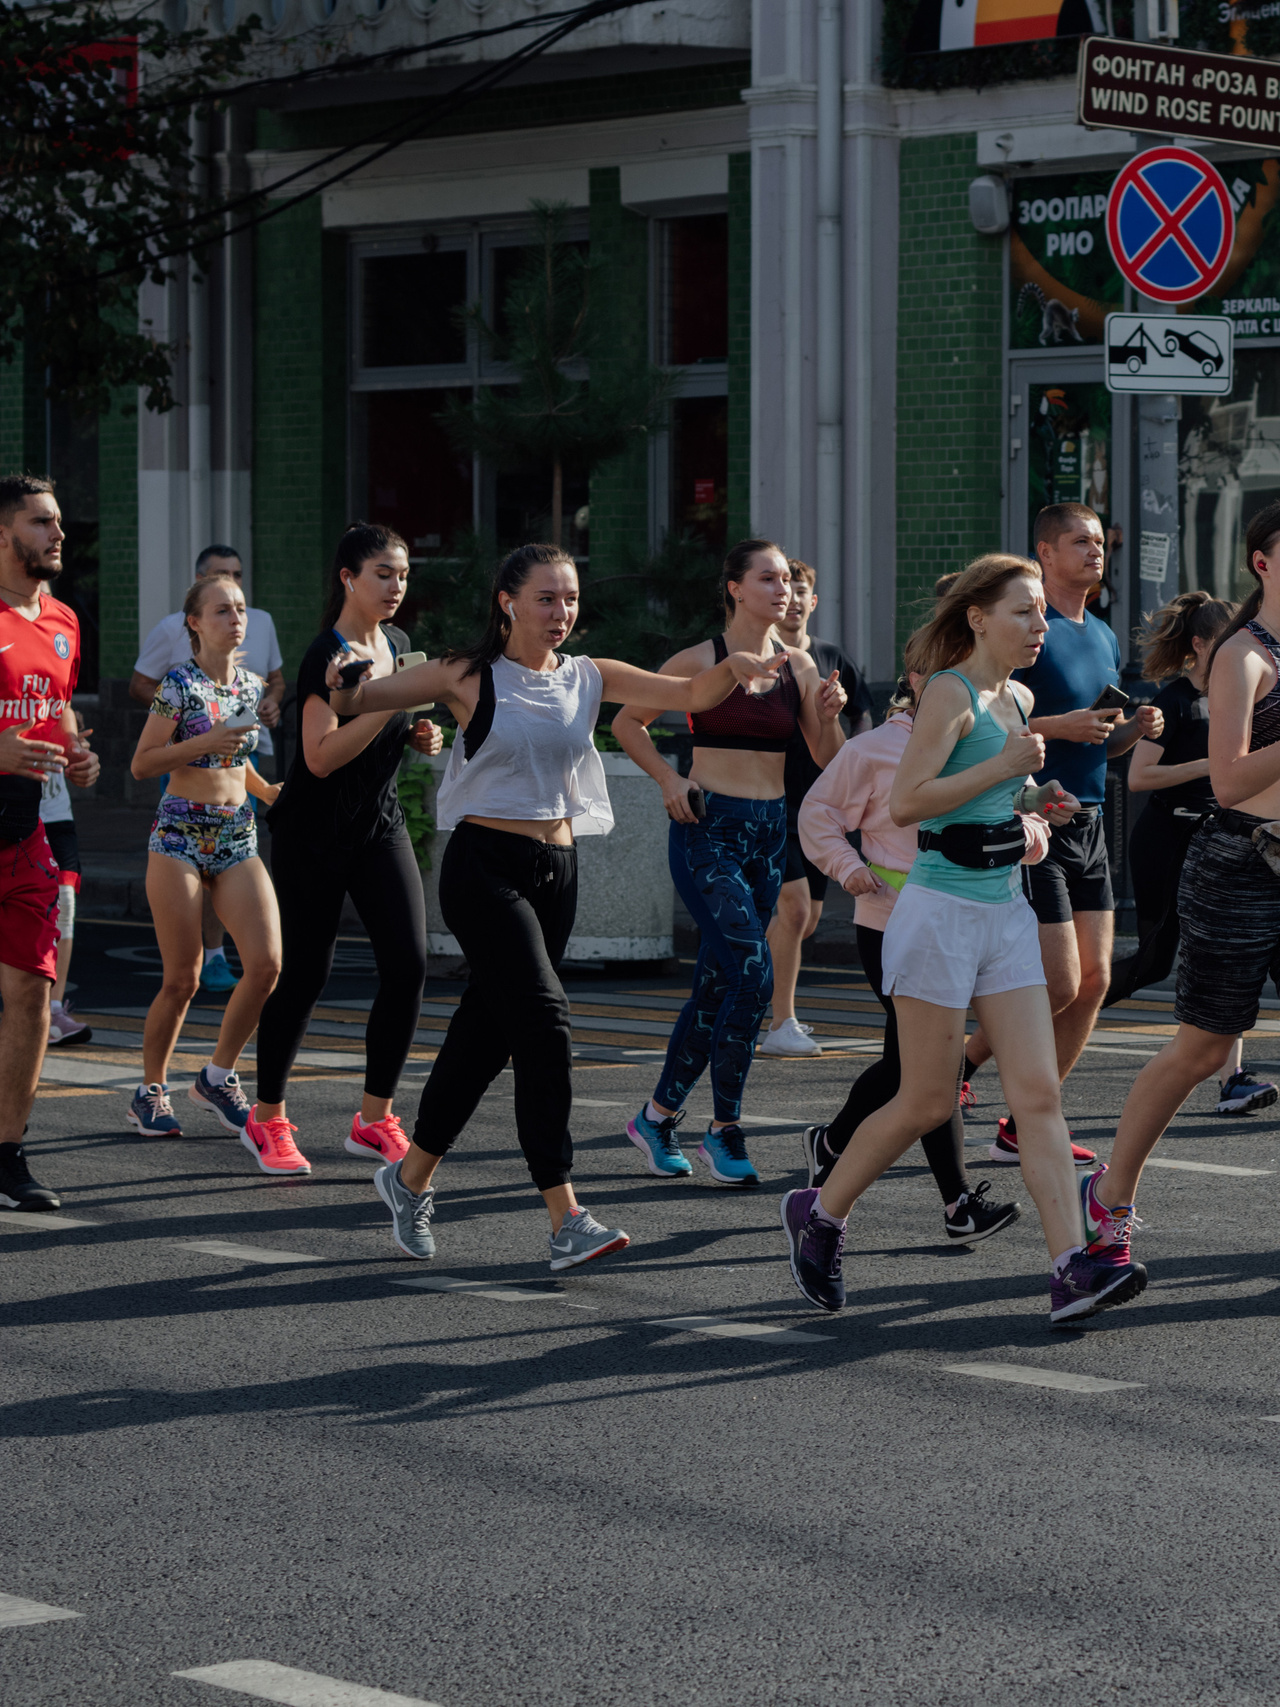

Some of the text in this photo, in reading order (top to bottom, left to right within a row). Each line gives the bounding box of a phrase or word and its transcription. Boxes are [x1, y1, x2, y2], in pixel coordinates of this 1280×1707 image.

[1092, 53, 1185, 87] ФОНТАН
[1191, 67, 1258, 97] «РОЗА
[1091, 87, 1149, 115] WIND
[1155, 95, 1213, 125] ROSE
[1018, 193, 1107, 224] ЗООПАР
[1046, 229, 1094, 258] РИО
[22, 673, 51, 696] Fly
[0, 693, 67, 721] mirate
